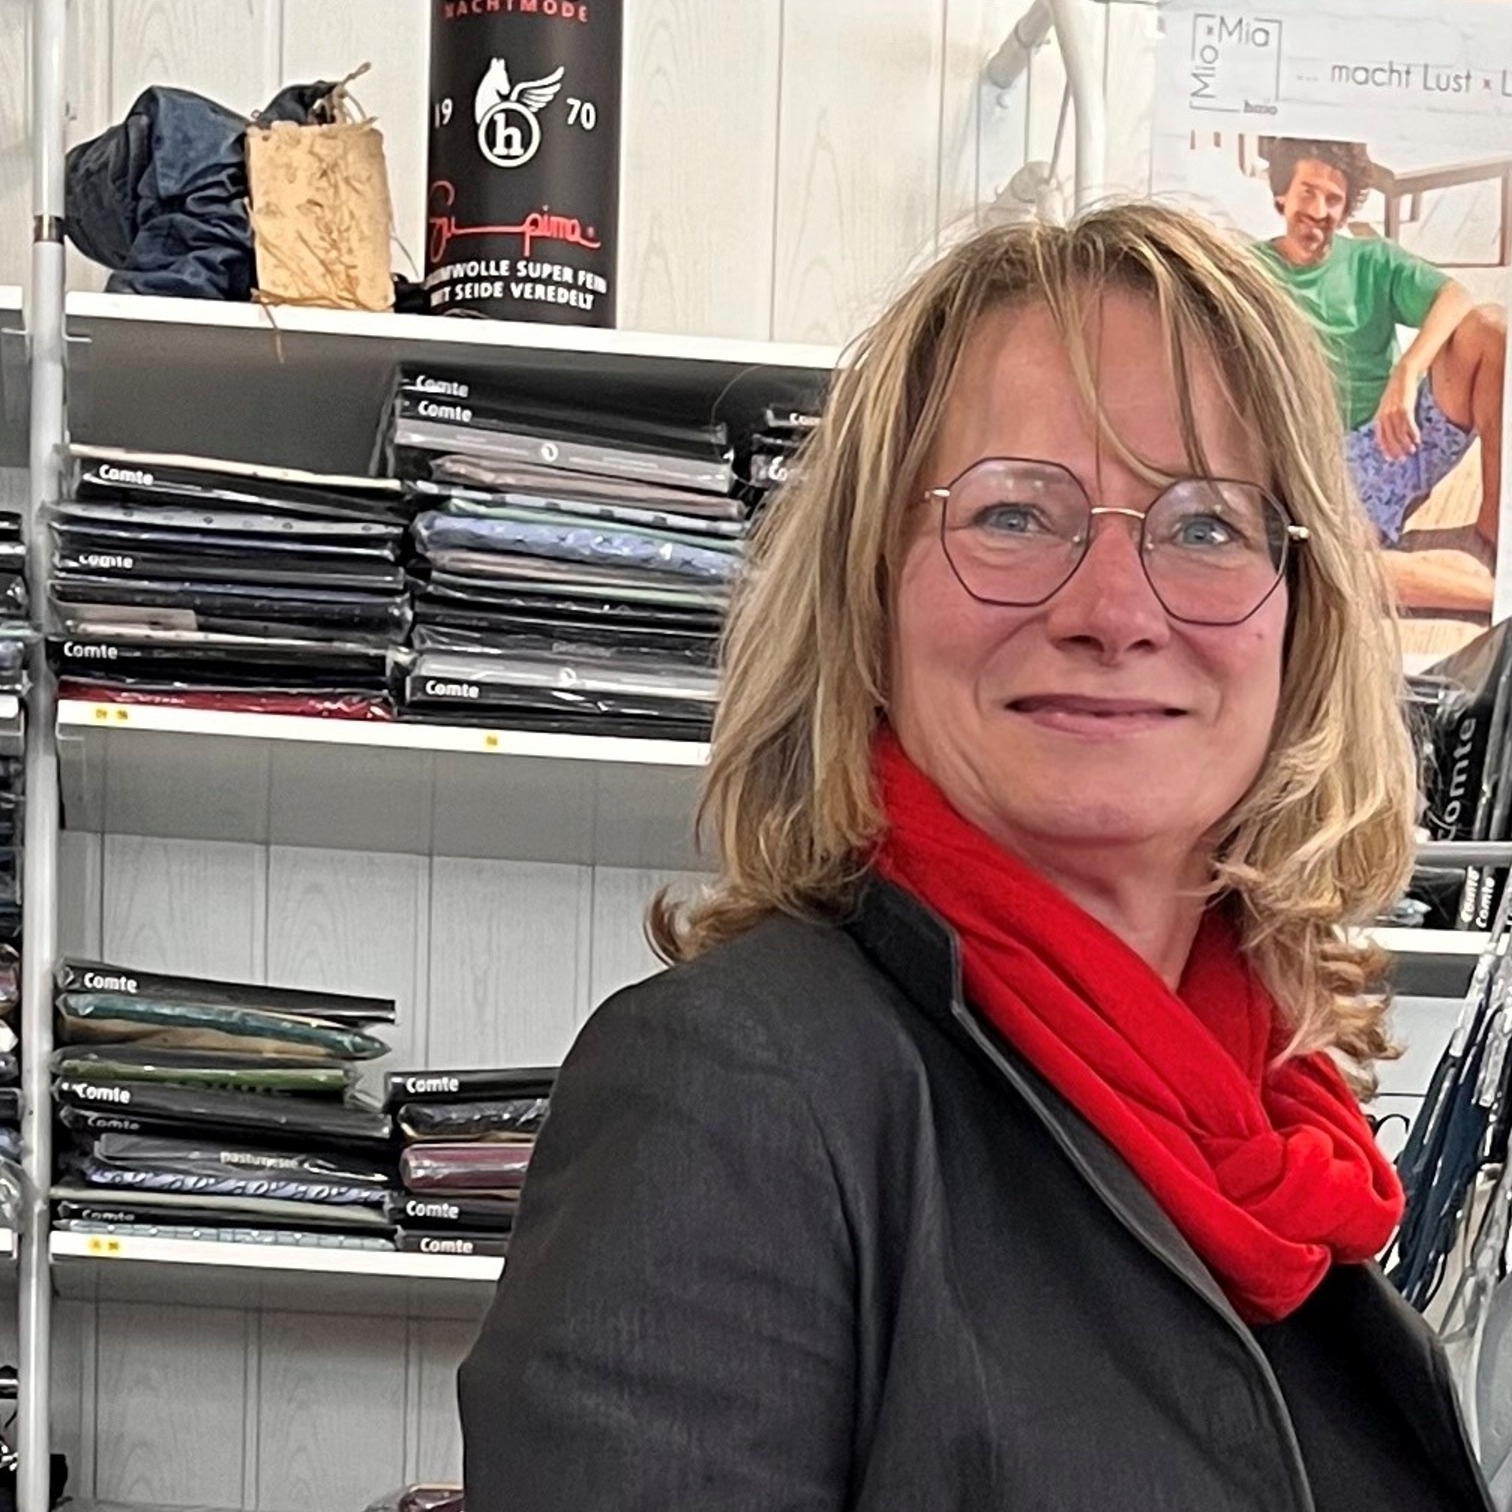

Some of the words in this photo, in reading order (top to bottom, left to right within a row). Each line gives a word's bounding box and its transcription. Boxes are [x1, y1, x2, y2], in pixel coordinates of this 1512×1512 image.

[1218, 15, 1270, 47] Mia
[1190, 45, 1219, 98] Mio
[1331, 62, 1411, 88] macht
[1422, 64, 1471, 93] Lust
[566, 98, 597, 130] 70
[516, 260, 573, 284] SUPER
[455, 281, 504, 300] SEIDE
[509, 282, 594, 311] VEREDELT
[415, 375, 468, 398] Comte
[418, 400, 472, 423] Comte
[98, 465, 154, 487] Comte
[63, 641, 118, 661] Comte
[425, 680, 479, 699] Comte
[84, 972, 138, 994] Comte
[77, 1084, 131, 1104] Comte
[406, 1077, 459, 1093] Comte
[406, 1201, 459, 1219] Comte
[419, 1238, 473, 1254] Comte
